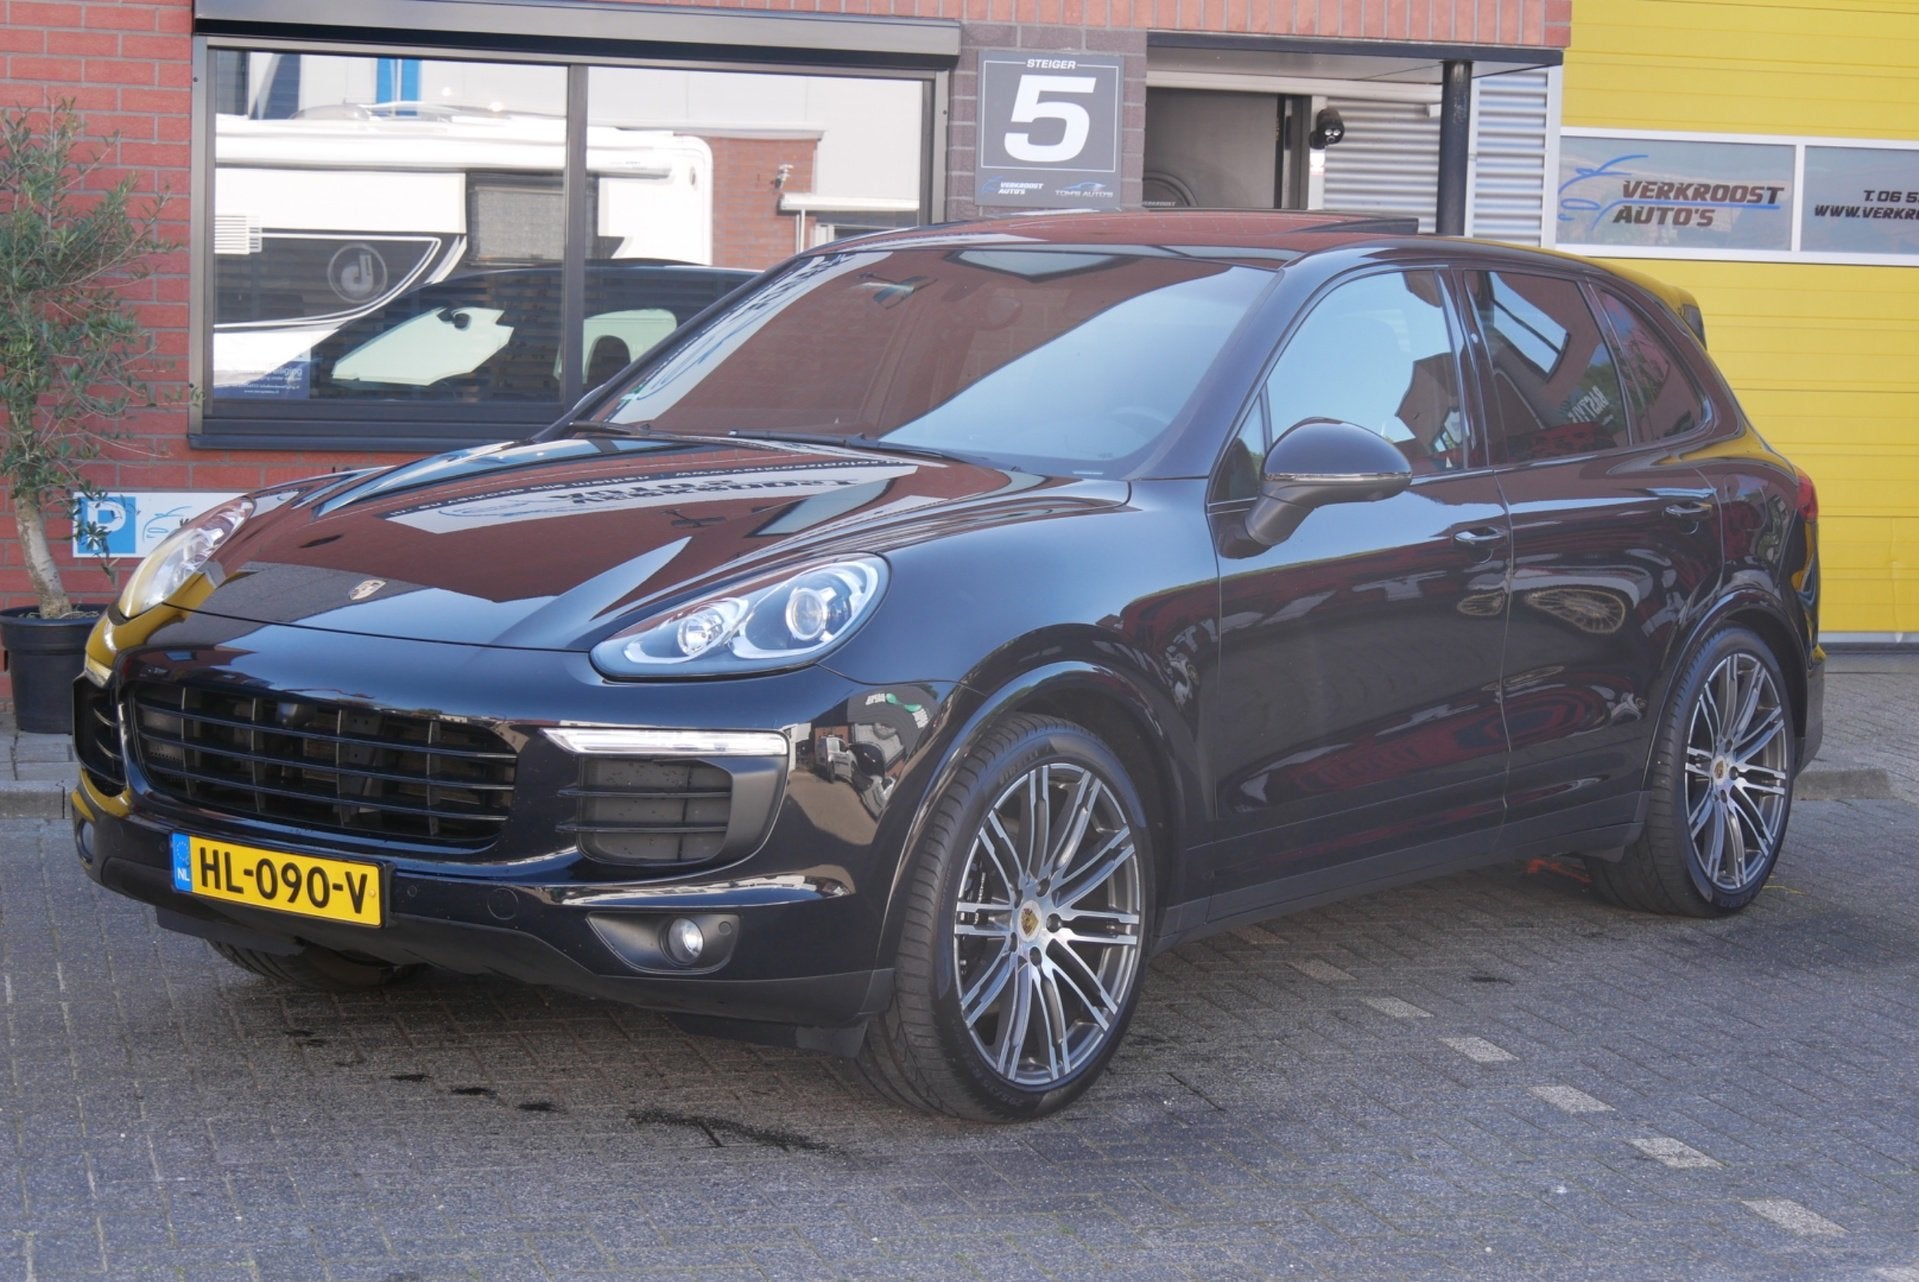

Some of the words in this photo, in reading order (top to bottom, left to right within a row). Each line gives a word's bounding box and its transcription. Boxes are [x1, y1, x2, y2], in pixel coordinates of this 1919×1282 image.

[1026, 58, 1077, 70] STEIGER
[1004, 74, 1097, 162] 5
[1622, 180, 1785, 205] VERKROOST
[1905, 191, 1919, 203] 5
[1612, 205, 1716, 227] AUTO'S
[177, 867, 190, 882] NL
[199, 846, 368, 914] HL-090-V
